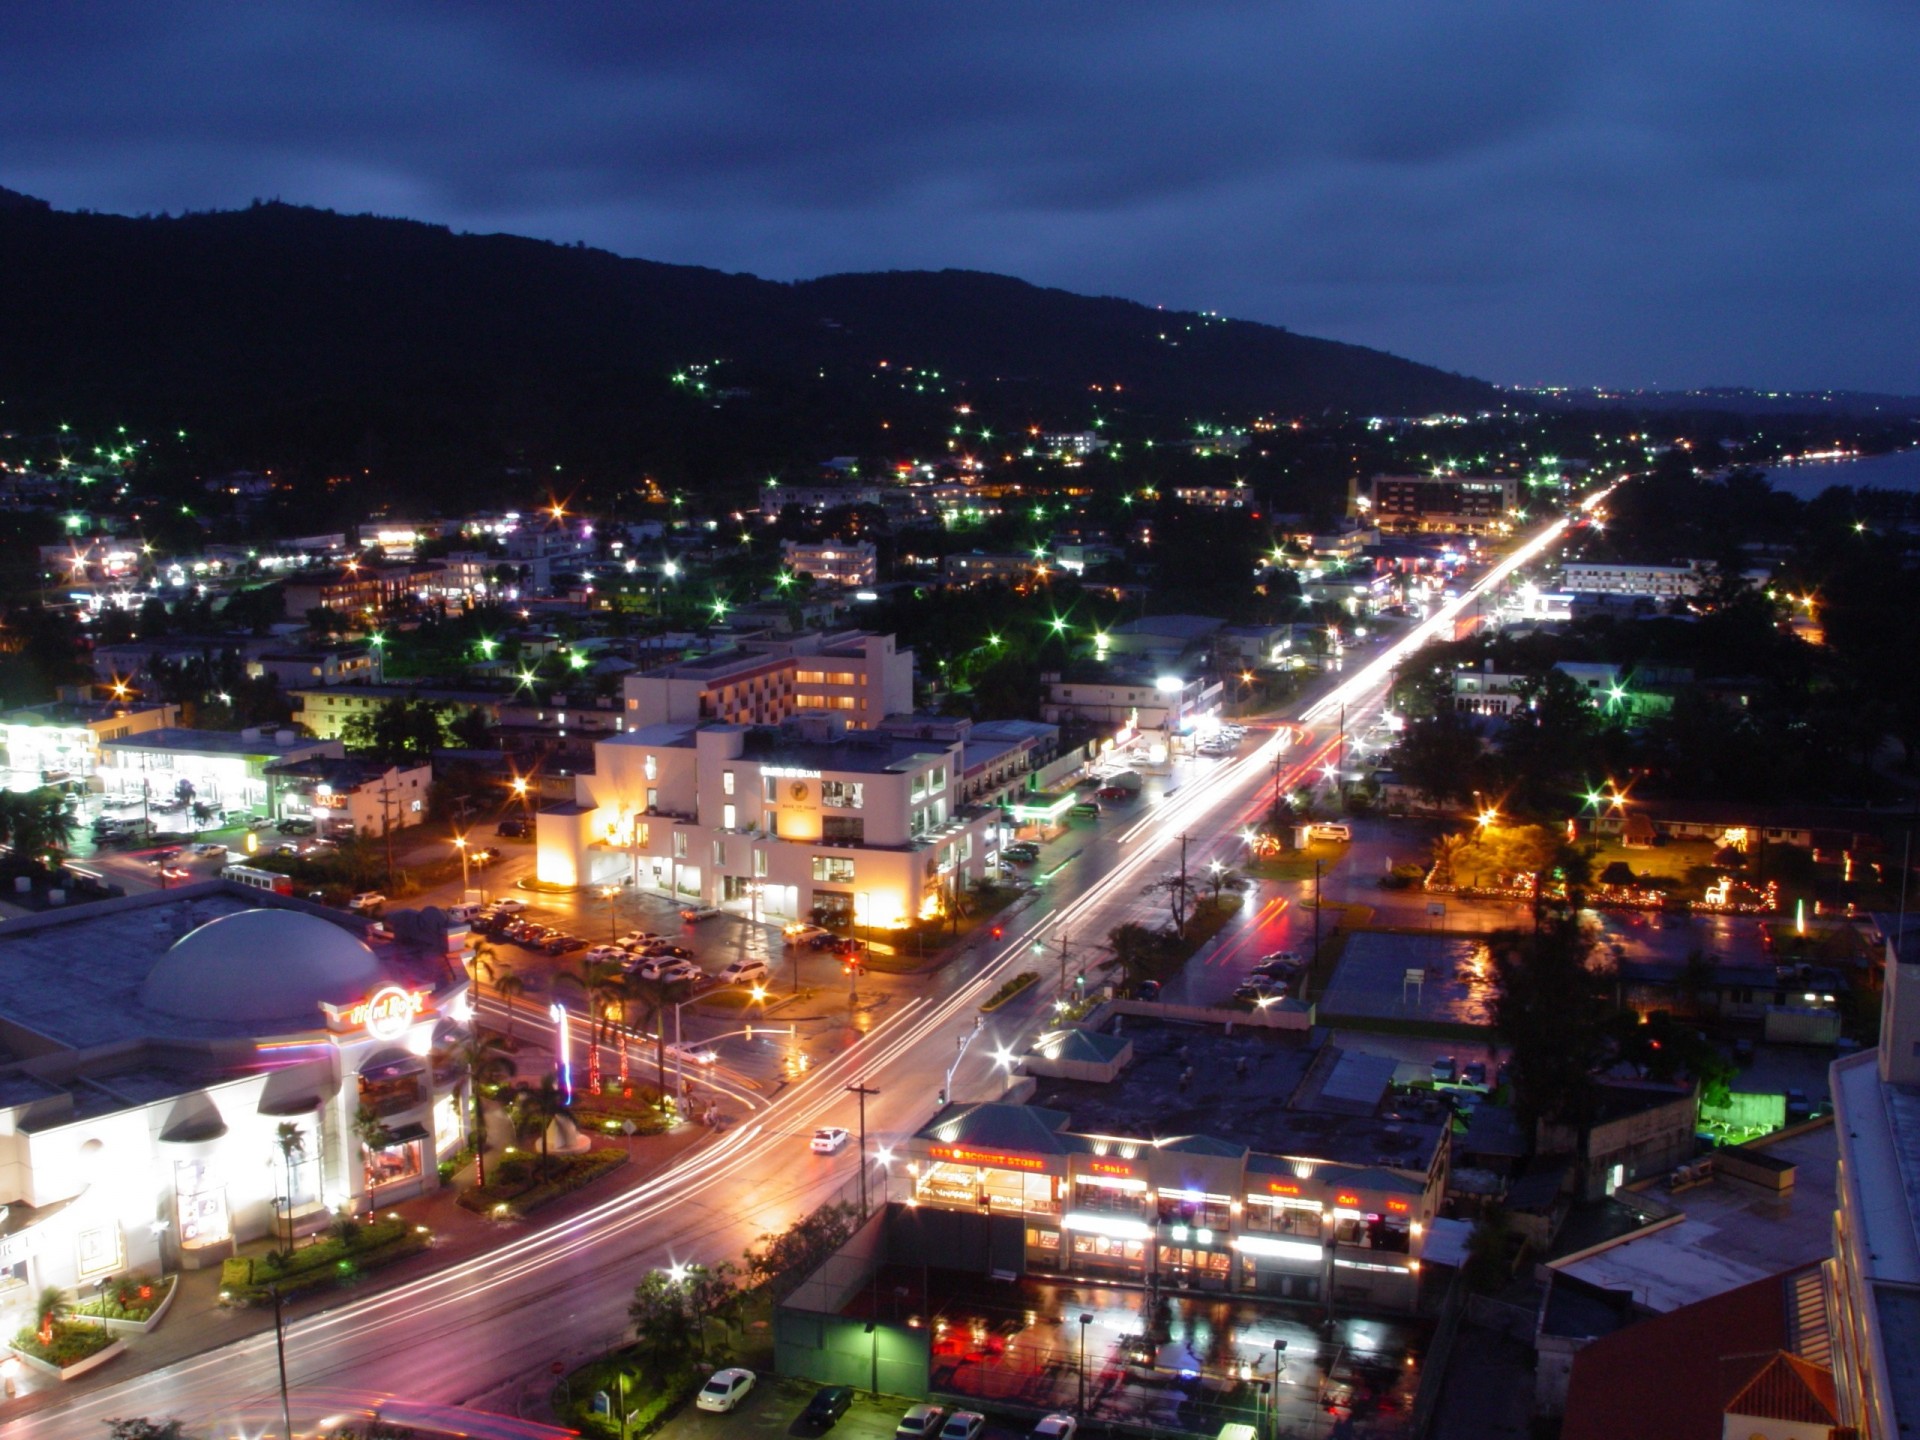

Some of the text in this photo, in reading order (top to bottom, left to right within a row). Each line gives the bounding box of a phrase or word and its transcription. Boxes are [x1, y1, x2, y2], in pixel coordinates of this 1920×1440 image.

[797, 768, 822, 779] GUAM
[389, 991, 423, 1018] Rock
[931, 1147, 1043, 1169] 123 DISCOUNT STORE
[1092, 1163, 1129, 1175] T-Shirt
